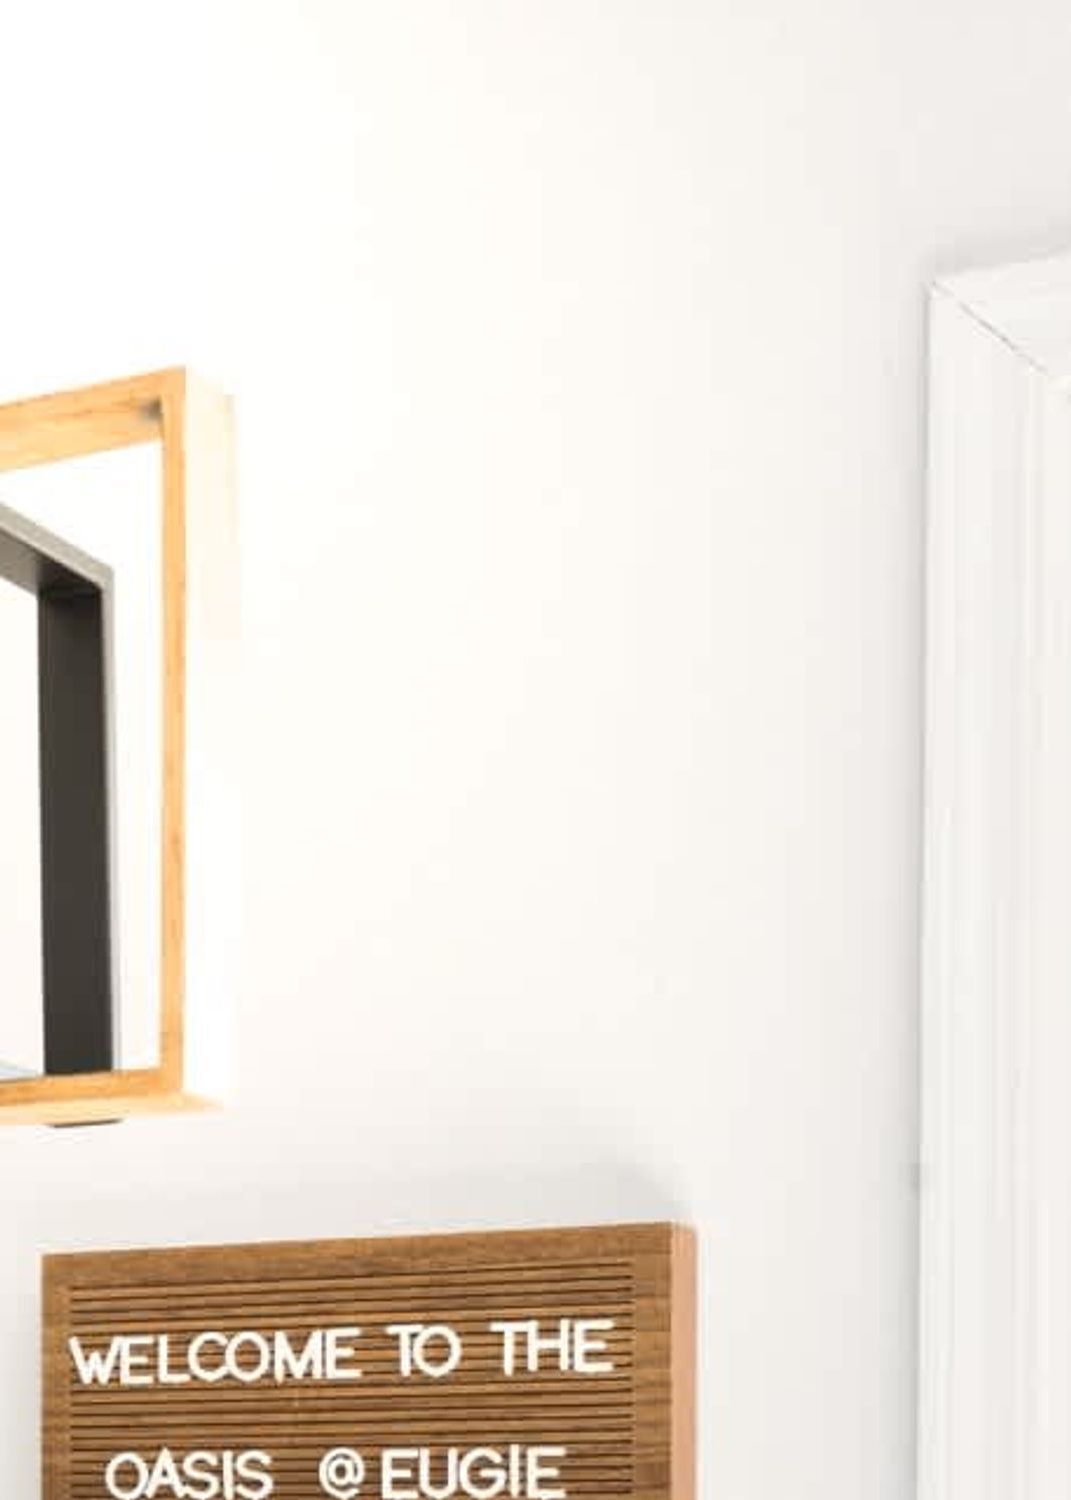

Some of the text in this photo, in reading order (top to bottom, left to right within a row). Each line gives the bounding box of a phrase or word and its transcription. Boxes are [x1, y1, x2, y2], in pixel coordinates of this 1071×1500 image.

[69, 1319, 615, 1385] WELCOME TO THE
[105, 1447, 274, 1500] OASIS
